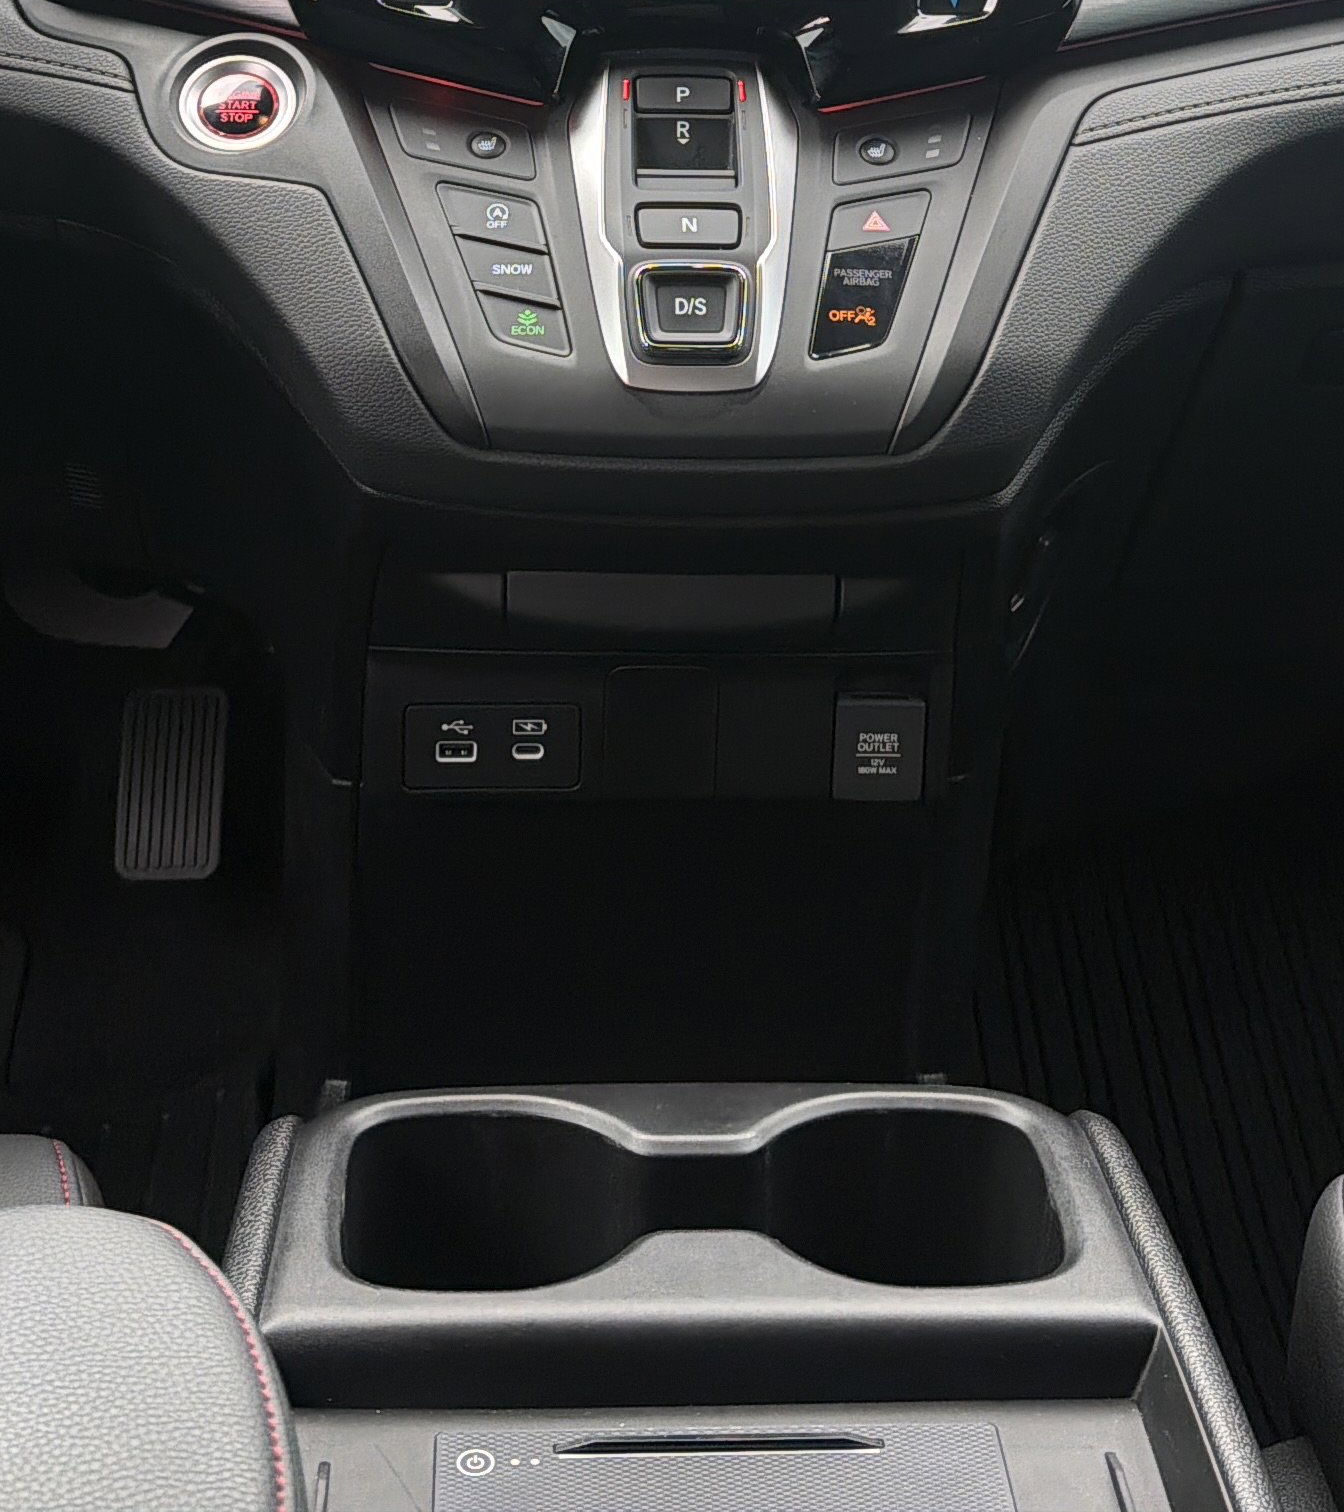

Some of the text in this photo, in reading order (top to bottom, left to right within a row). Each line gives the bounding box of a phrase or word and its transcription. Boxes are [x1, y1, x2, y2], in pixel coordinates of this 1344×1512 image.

[676, 87, 690, 103] P
[218, 100, 257, 110] START
[220, 112, 254, 123] STOP
[676, 121, 690, 138] R
[486, 220, 507, 229] OFF
[681, 217, 698, 233] N
[491, 263, 533, 275] SNOW
[833, 268, 893, 279] PASSENGER
[843, 277, 880, 286] AIRBAG
[674, 298, 707, 315] D/S
[828, 309, 856, 322] OFF
[510, 324, 545, 336] ECON
[859, 733, 899, 742] POWER
[857, 742, 900, 752] OUTLET
[870, 758, 886, 766] 12V
[878, 766, 897, 774] MAX
